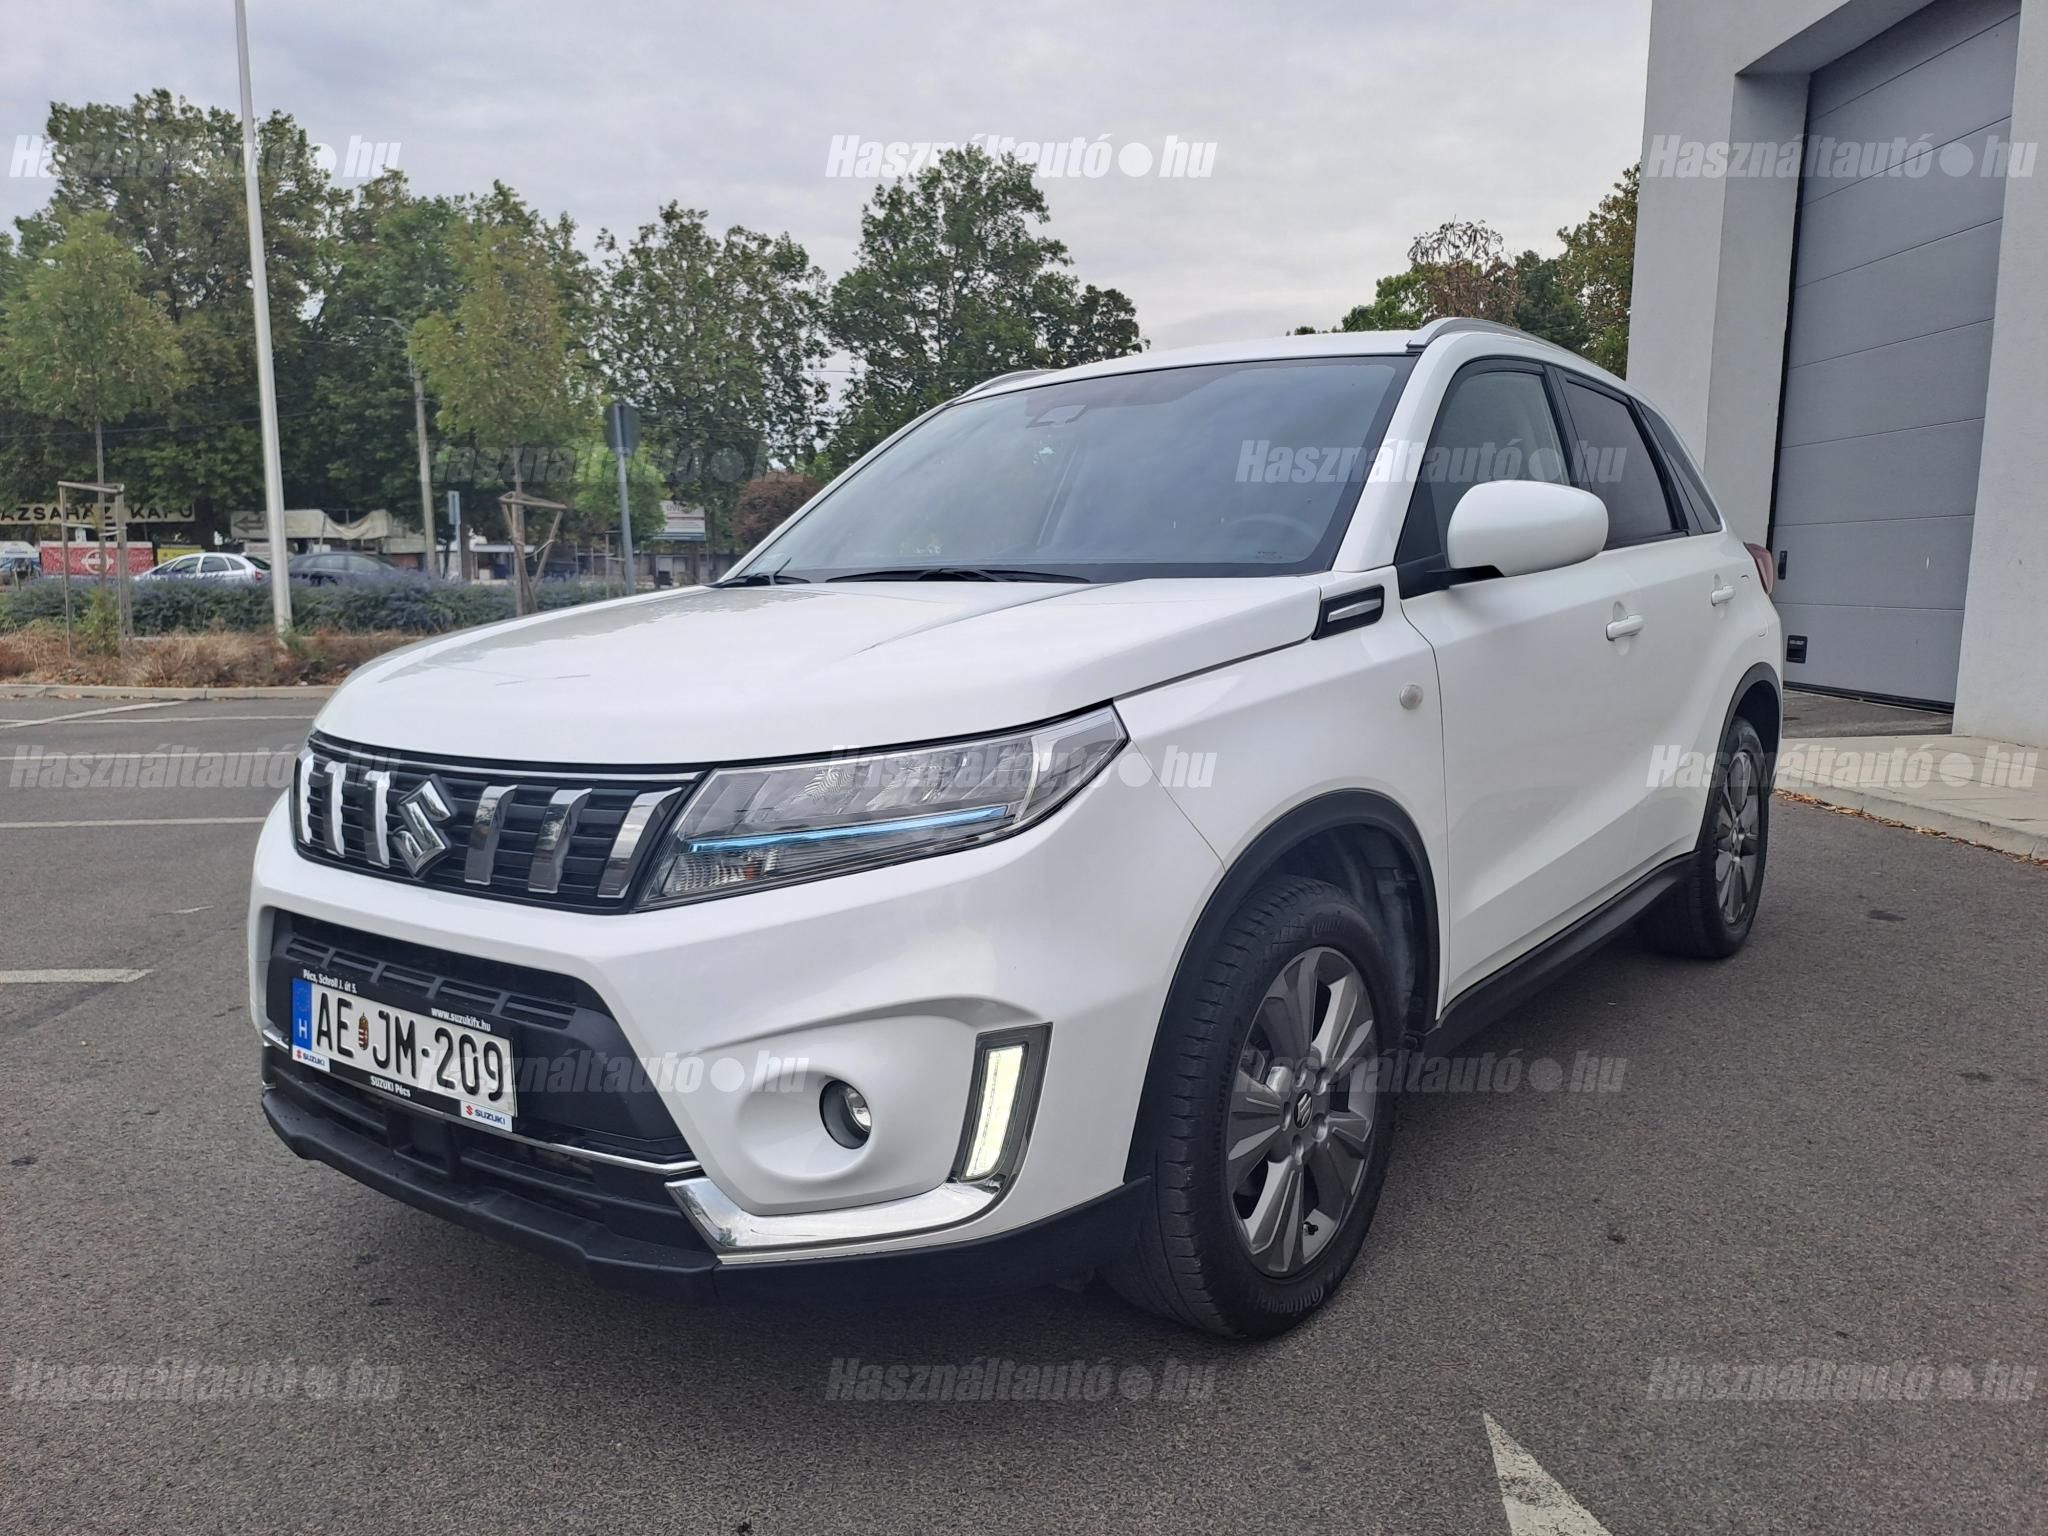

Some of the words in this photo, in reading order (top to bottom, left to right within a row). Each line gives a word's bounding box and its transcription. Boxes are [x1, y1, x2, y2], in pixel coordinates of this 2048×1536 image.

[298, 1018, 308, 1040] H
[316, 992, 354, 1058] AE
[303, 1052, 325, 1066] SUZUKI
[370, 1075, 394, 1092] SUZUKI
[474, 1109, 506, 1126] SUZUKI
